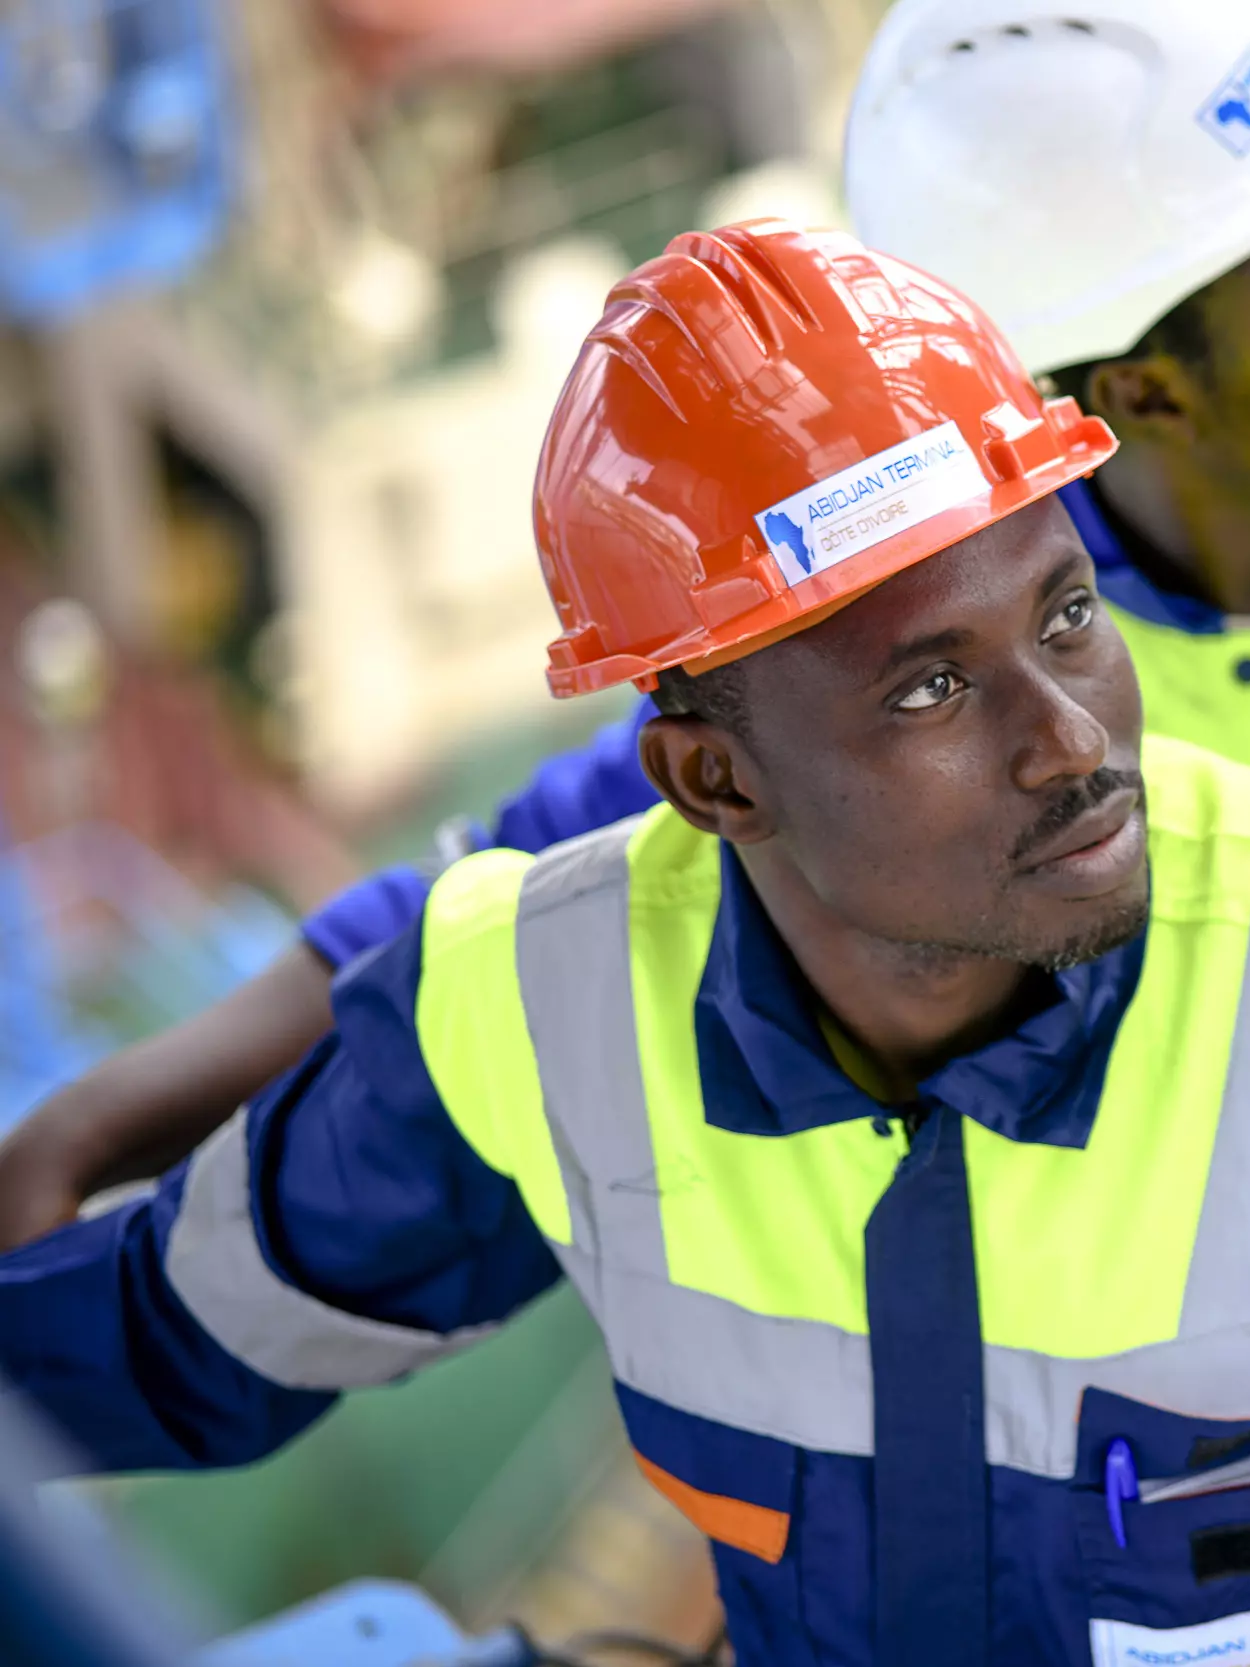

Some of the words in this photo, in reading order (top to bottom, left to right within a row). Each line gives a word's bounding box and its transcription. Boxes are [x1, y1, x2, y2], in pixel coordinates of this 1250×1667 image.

[808, 471, 884, 523] ABIDJAN
[820, 524, 856, 552] CÔTE
[857, 500, 909, 535] D'IVOIRE
